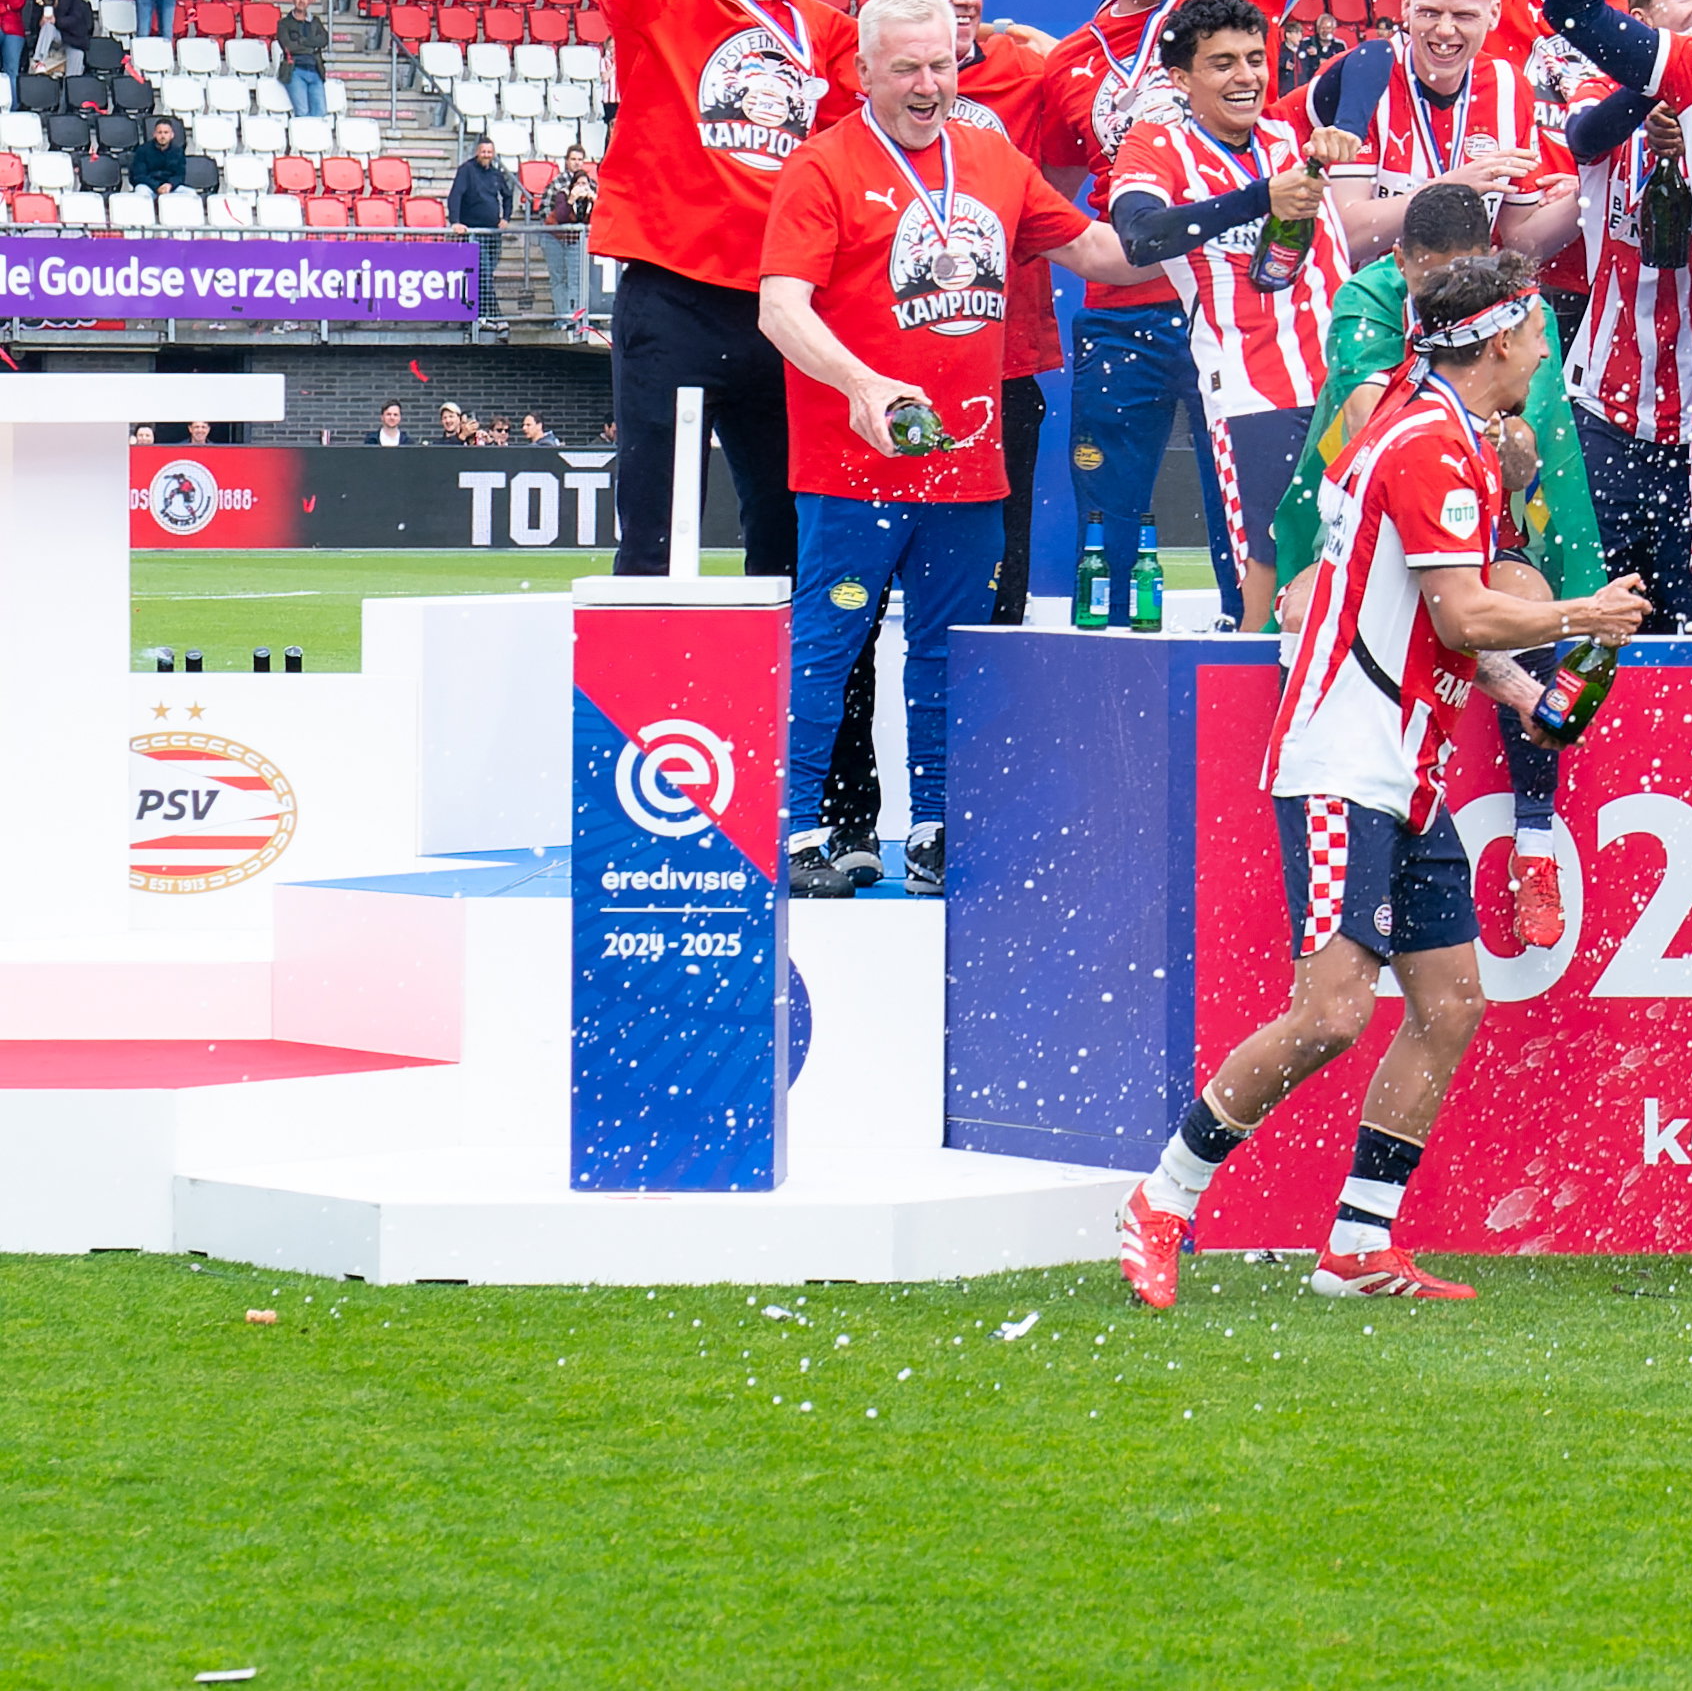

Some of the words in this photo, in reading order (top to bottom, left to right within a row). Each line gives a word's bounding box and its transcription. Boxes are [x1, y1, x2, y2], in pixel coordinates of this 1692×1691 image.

[717, 42, 743, 70] PSV
[38, 256, 184, 298] Goudse
[190, 258, 470, 309] verzekeringen
[891, 289, 1007, 331] KAMPIOEN
[458, 471, 622, 546] TOT
[1446, 505, 1476, 524] TOTO
[135, 789, 221, 821] PSV
[148, 877, 174, 892] EST
[176, 878, 207, 892] 1913
[601, 863, 748, 891] eredivisie
